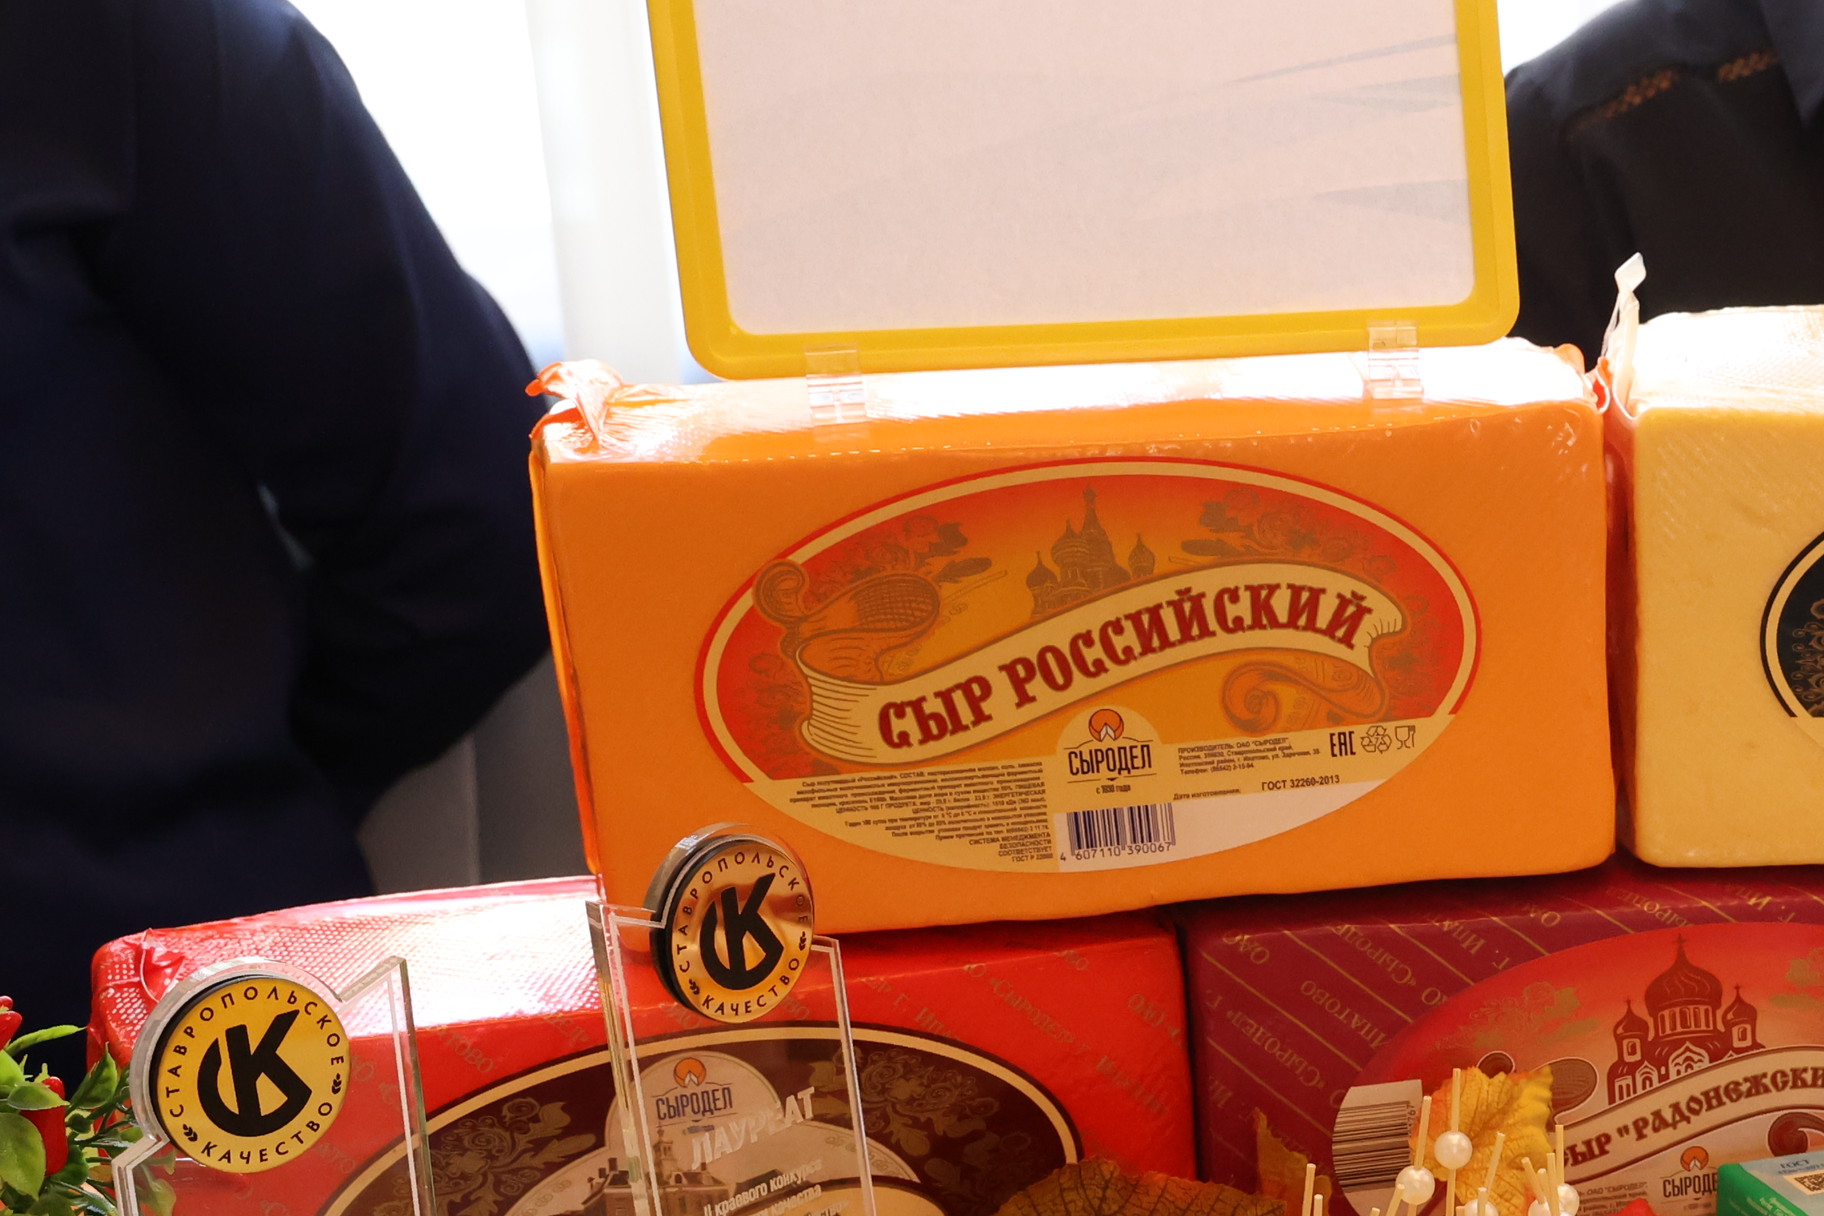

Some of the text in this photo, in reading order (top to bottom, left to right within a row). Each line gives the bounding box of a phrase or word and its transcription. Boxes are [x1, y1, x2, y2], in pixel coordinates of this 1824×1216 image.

[878, 583, 1373, 748] СЫР РОССИЙСКИЙ
[1068, 745, 1151, 776] СЫРОДЕЛ
[1262, 775, 1340, 790] ГОСТ 32260-2013
[1059, 841, 1172, 861] 4 607110 390067
[702, 958, 799, 1016] КАЧЕСТВО
[165, 986, 345, 1118] СТАВРОПОЛЬСКОЕ
[656, 1087, 733, 1120] СЫРОДЕЛ
[201, 1102, 333, 1164] КАЧЕСТВО
[1662, 1172, 1718, 1198] СЫРОДЕ
